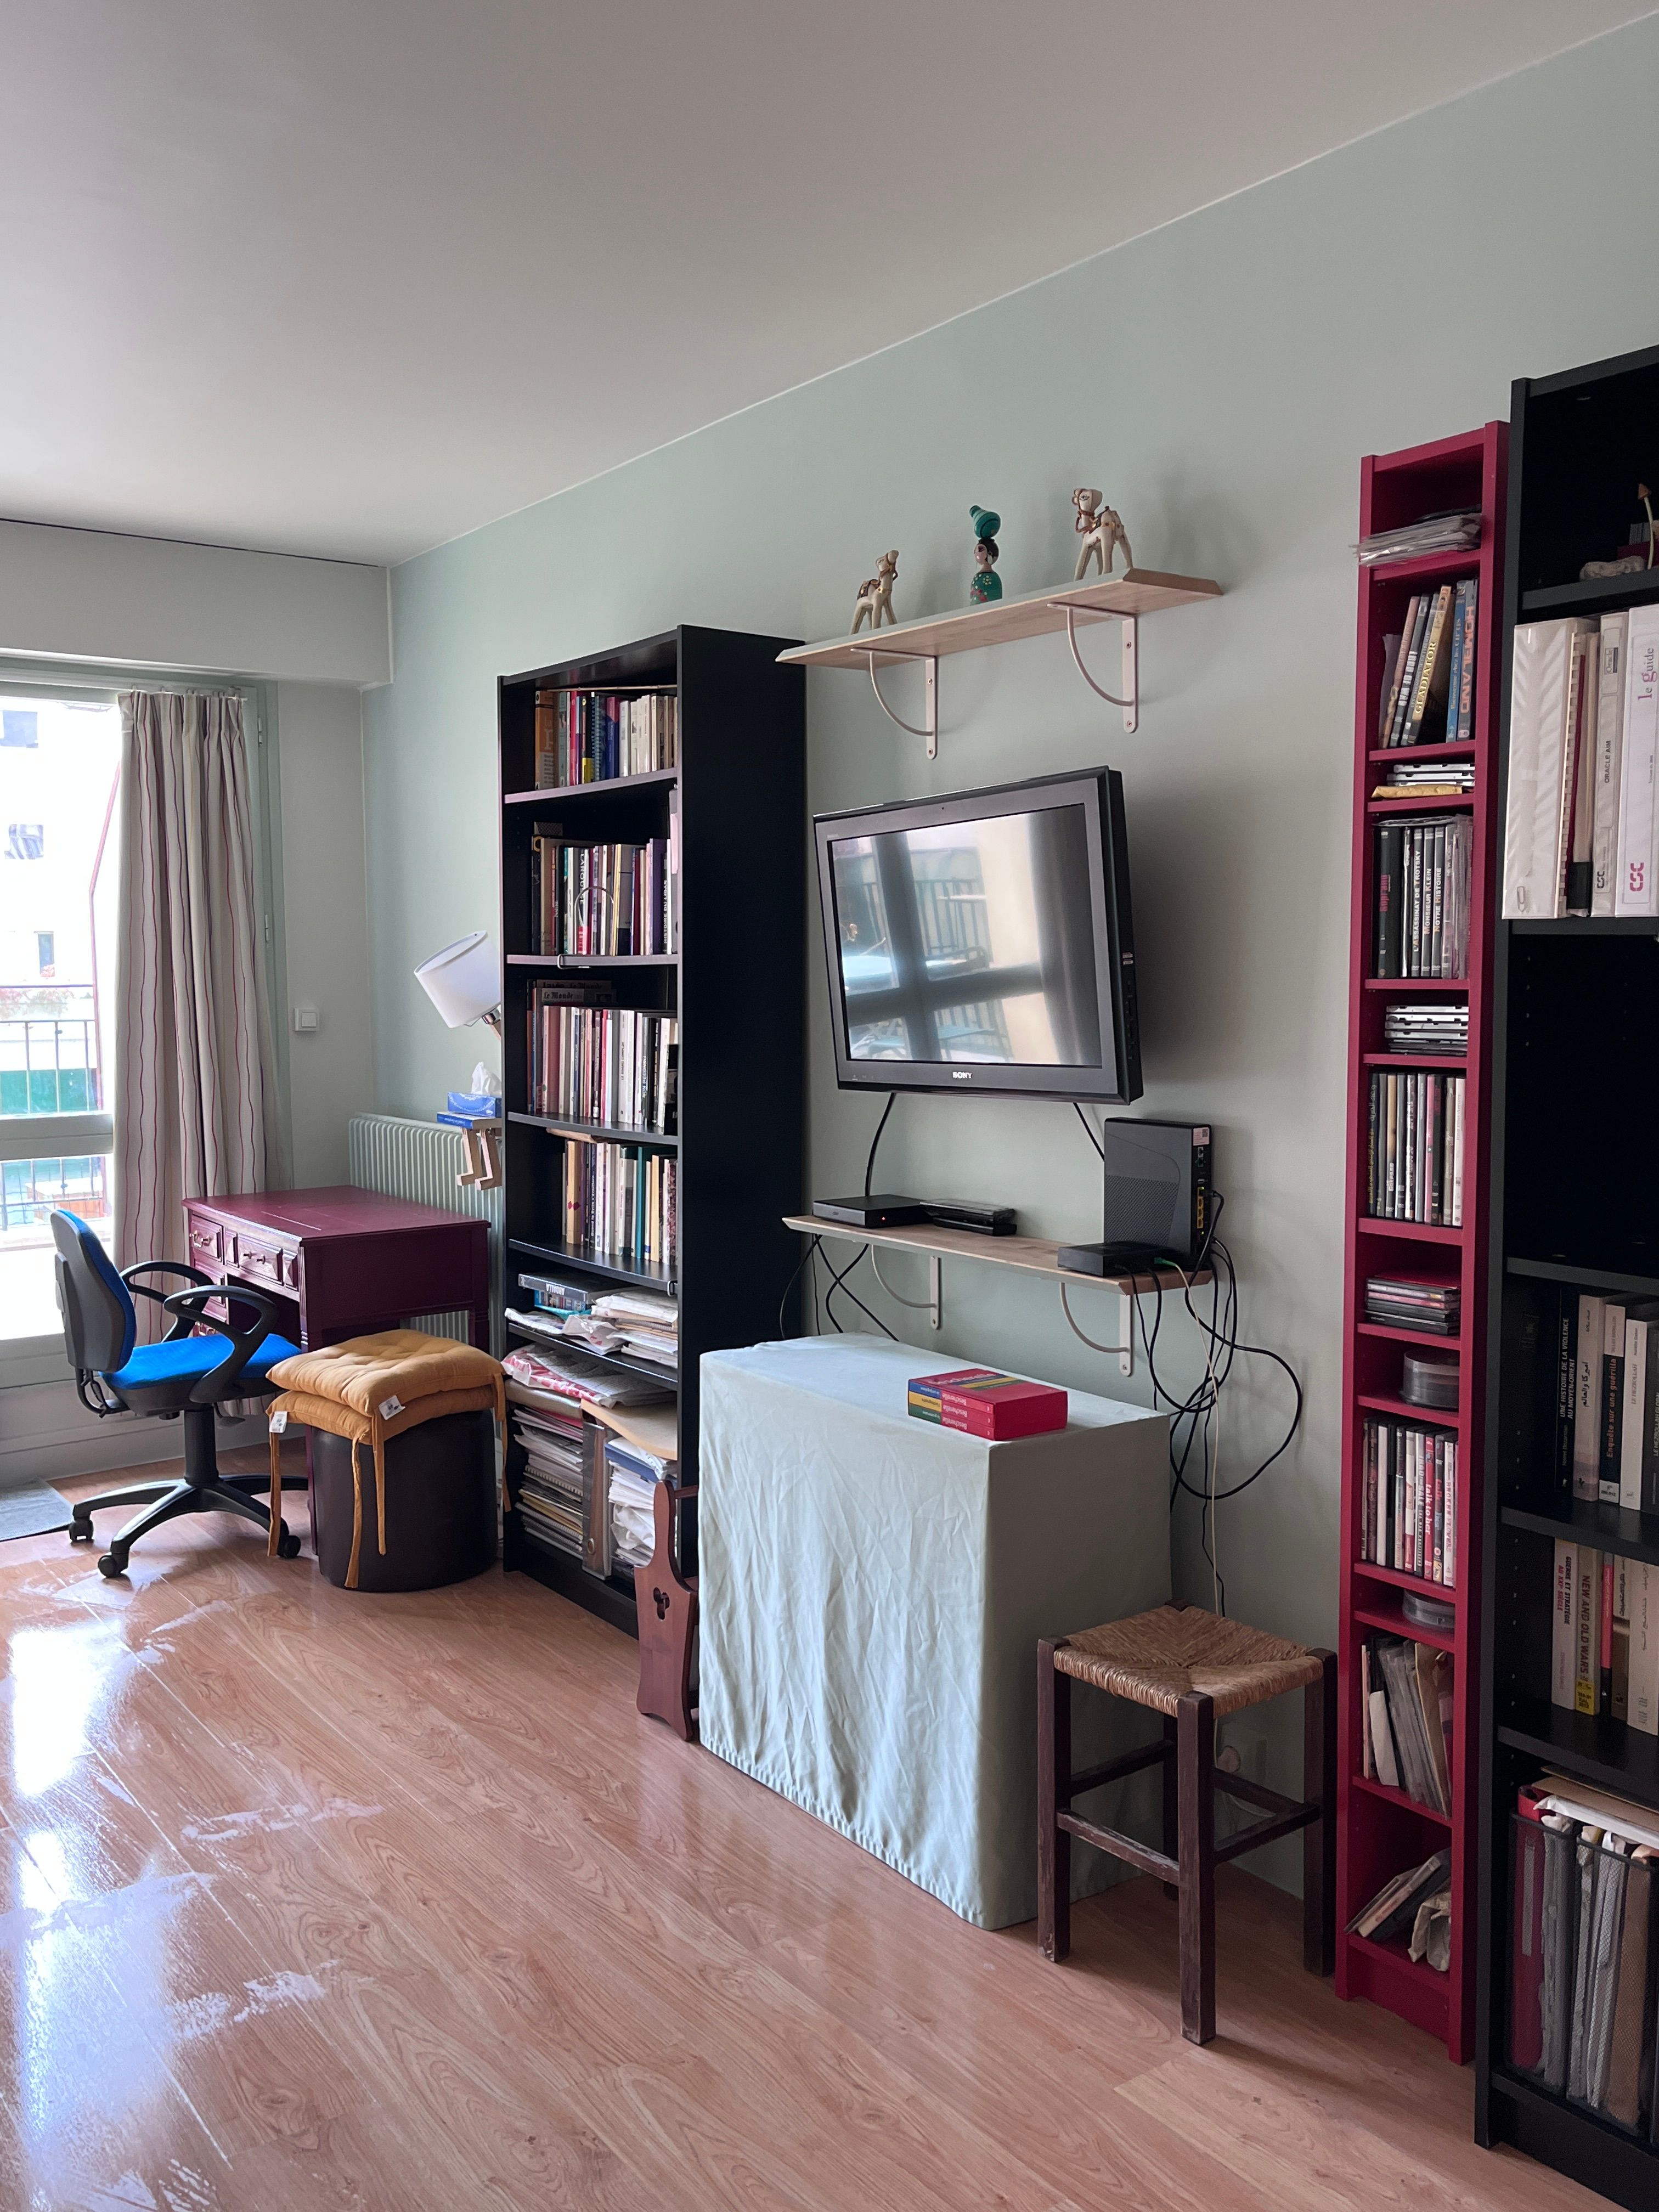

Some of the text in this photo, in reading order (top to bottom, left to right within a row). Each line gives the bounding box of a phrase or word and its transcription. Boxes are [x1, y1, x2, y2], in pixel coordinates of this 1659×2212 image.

[1414, 641, 1436, 714] GLADIATOR
[1638, 647, 1657, 699] le guide
[1596, 871, 1606, 889] CSC
[1630, 862, 1645, 891] CSC
[1414, 888, 1420, 898] DE
[1562, 1351, 1567, 1359] LA
[1561, 1362, 1567, 1370] DE
[1608, 1358, 1617, 1390] guérilla
[1567, 1410, 1573, 1419] AU
[1606, 1425, 1616, 1457] Enquête
[1425, 1506, 1431, 1516] to
[1558, 1565, 1564, 1573] AU
[1565, 1582, 1571, 1590] ET
[1582, 1576, 1590, 1599] NEW
[1581, 1599, 1590, 1622] AND
[1581, 1624, 1589, 1642] OLD
[1581, 1646, 1589, 1673] WARS
